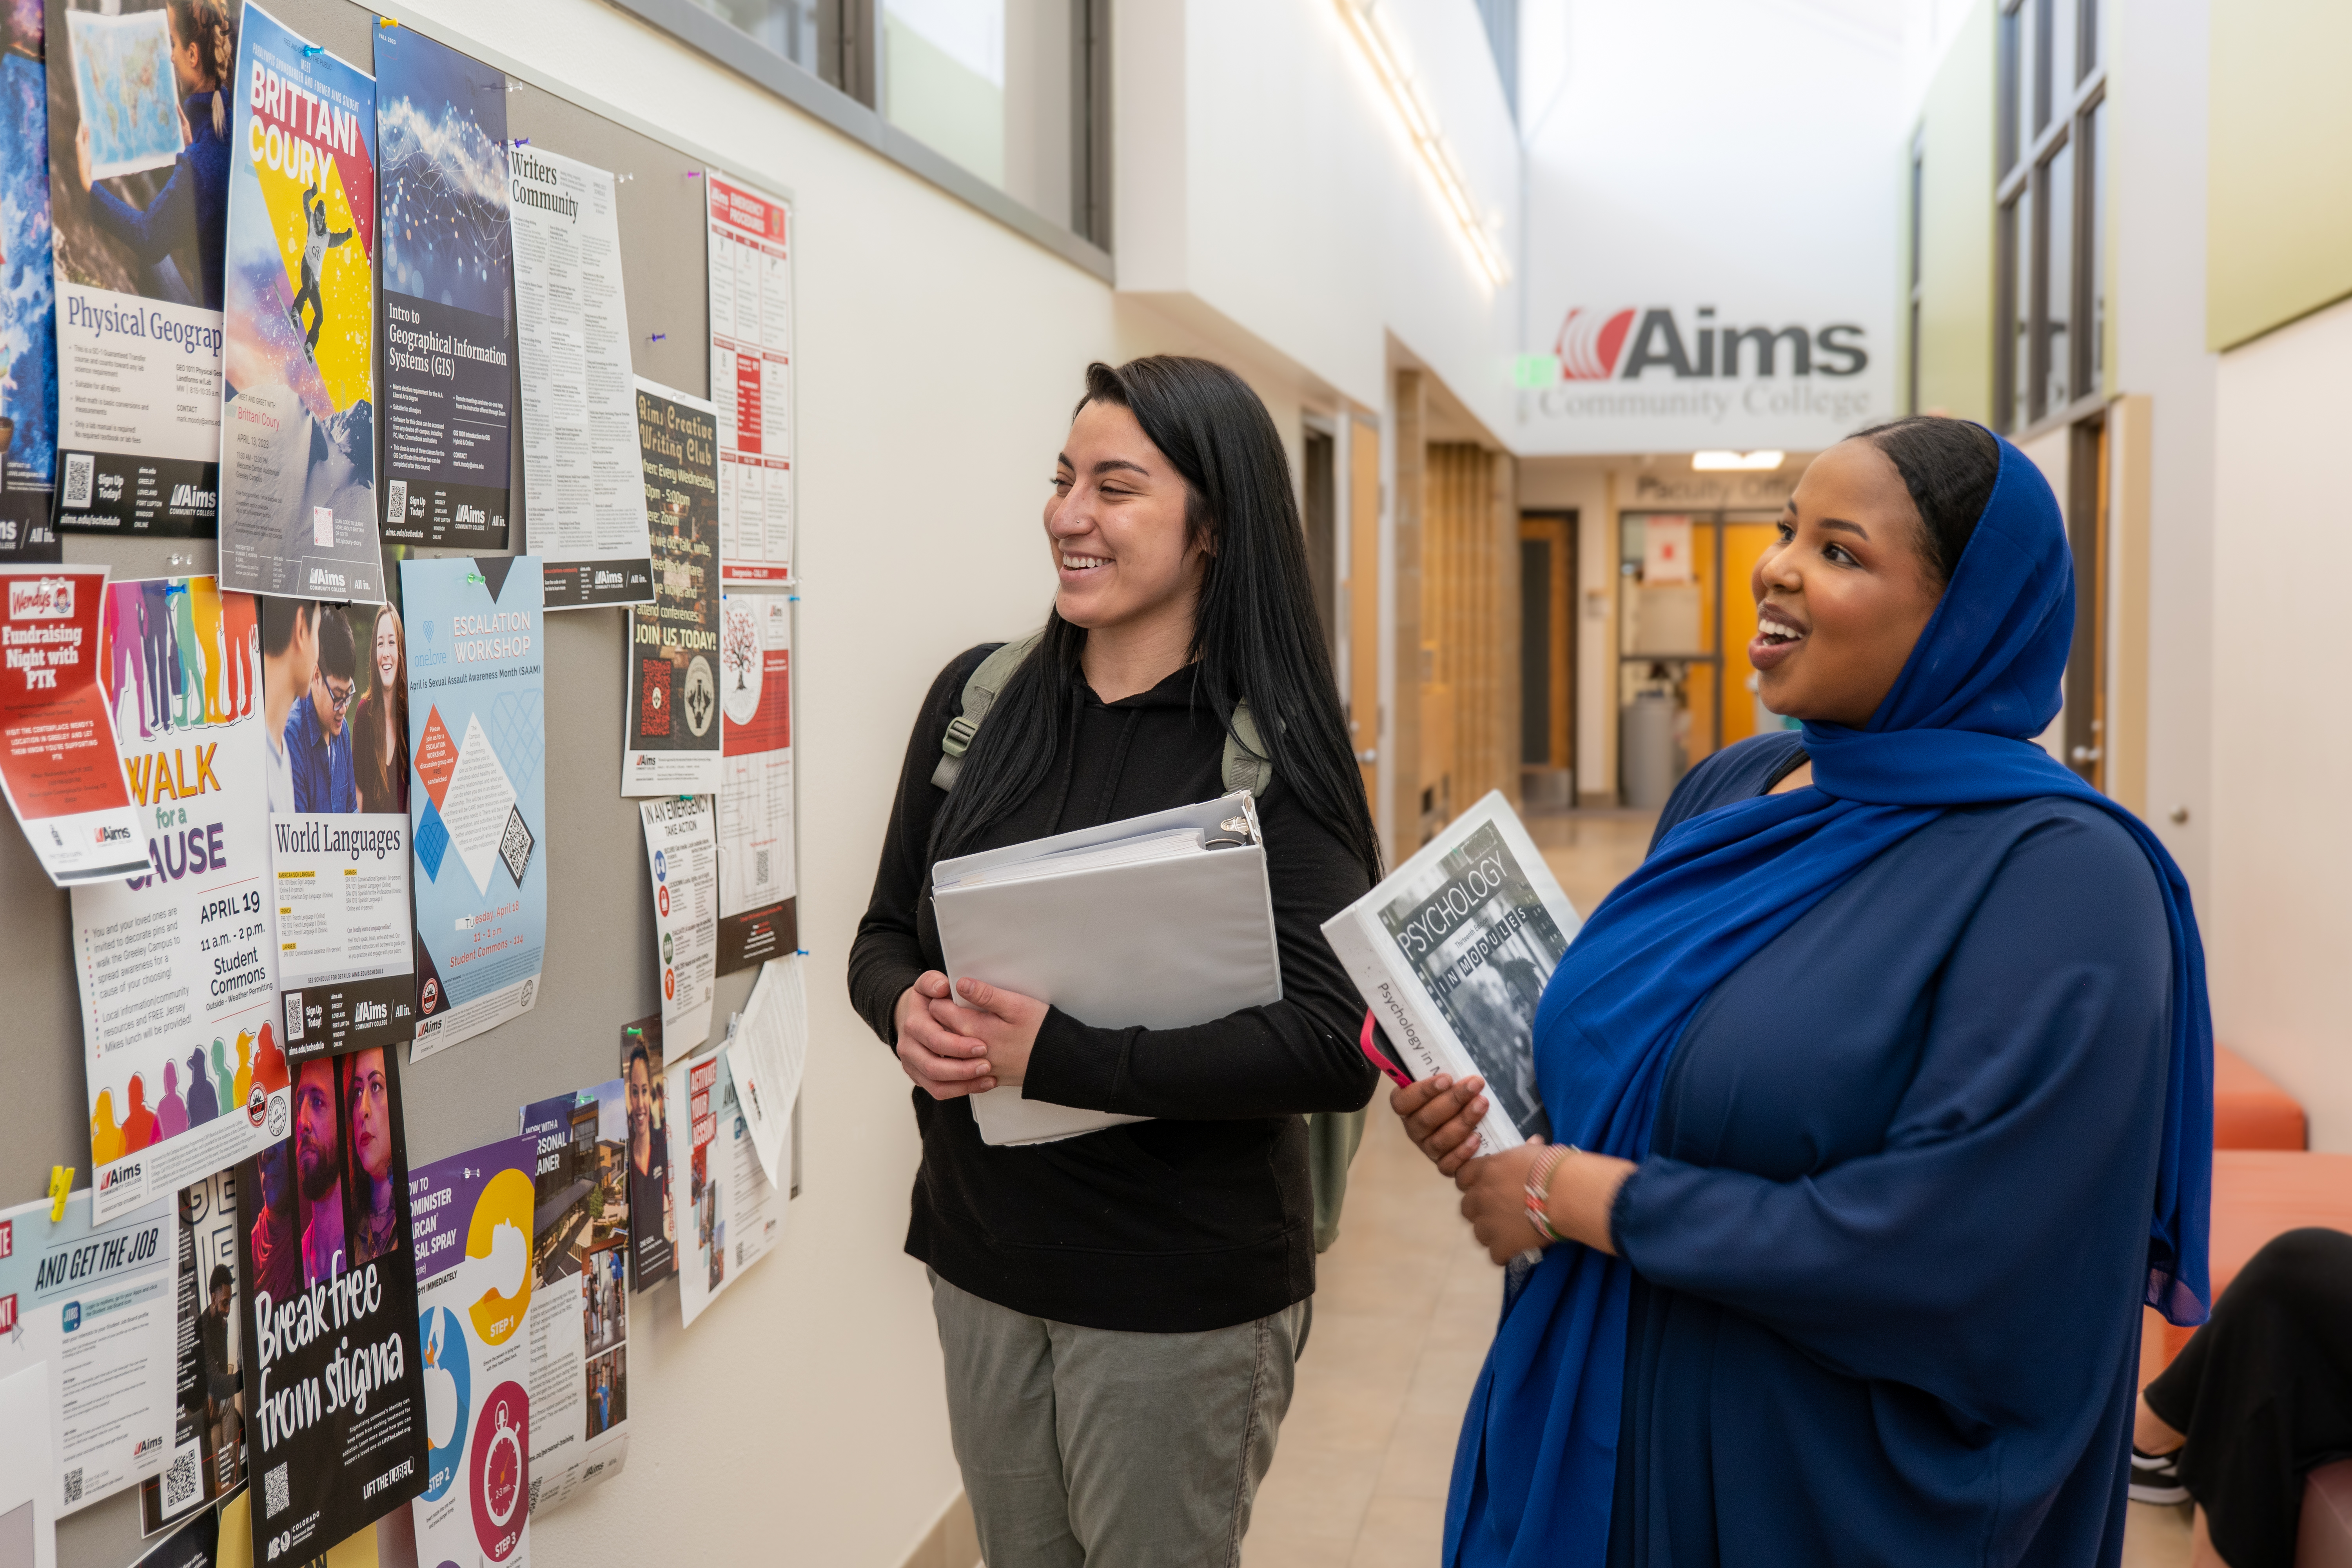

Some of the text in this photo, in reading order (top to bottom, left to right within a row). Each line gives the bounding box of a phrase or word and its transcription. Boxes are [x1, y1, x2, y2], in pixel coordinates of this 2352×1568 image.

[388, 36, 396, 45] 2023
[253, 42, 275, 66] PARALYMPIC
[276, 58, 303, 83] SNOWBOARDER
[314, 80, 330, 97] FORMER
[331, 89, 341, 103] AIMS
[343, 95, 359, 113] STUDENT
[301, 59, 310, 73] MEET
[250, 59, 356, 158] BRITTANI
[249, 115, 334, 193] COURY
[511, 151, 556, 185] Writers
[513, 180, 578, 224] Community
[67, 296, 223, 357] Physical Geograp
[389, 303, 420, 324] Intro to
[389, 324, 507, 366] Geographical Information
[1621, 306, 1868, 380] Aims
[390, 347, 454, 381] Systems (GIS)
[256, 398, 267, 406] GREET
[1539, 381, 1871, 425] Community College
[238, 407, 279, 432] Brittani Coury
[639, 395, 713, 441] Aims Creative
[237, 434, 250, 444] APRIL
[258, 439, 269, 448] 2023
[640, 423, 711, 466] Writing Club
[659, 463, 716, 494] Every Wednesday
[184, 486, 216, 508] Aims
[666, 488, 690, 506] 5:00pm
[336, 538, 361, 547] bit.ly/coury-story
[385, 528, 423, 538] aims.edu/schedule
[318, 569, 345, 586] Aims
[601, 570, 623, 584] Aims
[2, 624, 82, 646] Fundraising
[454, 611, 530, 637] ESCALATION
[454, 636, 531, 663] WORKSHOP
[636, 624, 717, 652] JOIN US TODAY!
[6, 646, 79, 671] Night with
[415, 649, 446, 667] onelove
[26, 670, 56, 689] PTK
[410, 665, 541, 693] April is Sexual Assault Awareness Month (SAAM)
[124, 742, 221, 807] WALK
[156, 807, 187, 829] for a
[644, 794, 708, 825] IN AN EMERGENCY
[103, 826, 131, 841] Aims
[275, 822, 400, 860] World Languages
[664, 820, 697, 837] TAKE ACTION
[201, 891, 260, 924] APRIL 19
[496, 903, 510, 918] April
[512, 900, 519, 912] 18
[1397, 850, 1507, 961] PSYCHOLOGY
[201, 923, 265, 951] 11 a.m. 2 p.m.
[474, 927, 502, 943] 11 1 p.m.
[1454, 917, 1489, 949] Thirteenth Edition
[214, 947, 258, 975] Student
[450, 934, 523, 967] Student Commons 114
[1439, 907, 1526, 993] IN MODULES
[211, 967, 266, 996] Commons
[352, 969, 384, 978] AIMS.EDU/SCHEDULE
[206, 982, 273, 1011] Outside Weather Permitting
[362, 1001, 387, 1021] Aims
[1377, 982, 1433, 1065] Psychology in
[355, 1019, 387, 1030] COMMUNITY COLLEGE
[289, 1041, 324, 1056] aims.edu/schedule
[526, 1119, 558, 1134] WORK WITH A
[110, 1162, 141, 1187] Aims
[431, 1229, 457, 1254] SPRAY
[34, 1227, 159, 1292] AND GET THE JOB
[426, 1270, 457, 1291] IMMEDIATELY
[64, 1307, 78, 1323] JOBS
[255, 1277, 329, 1371] Break
[328, 1250, 381, 1329] free
[490, 1315, 514, 1338] STEP 1
[256, 1333, 404, 1452] from stigma
[349, 1418, 370, 1433] Stigmatizing
[370, 1408, 388, 1422] someone's
[389, 1401, 402, 1412] identity
[140, 1435, 163, 1454] Aims
[363, 1459, 414, 1500] LIFT THE LABEL
[428, 1467, 450, 1492] STEP 2
[292, 1511, 320, 1532] COLORADO
[495, 1532, 516, 1558] STEP 3
